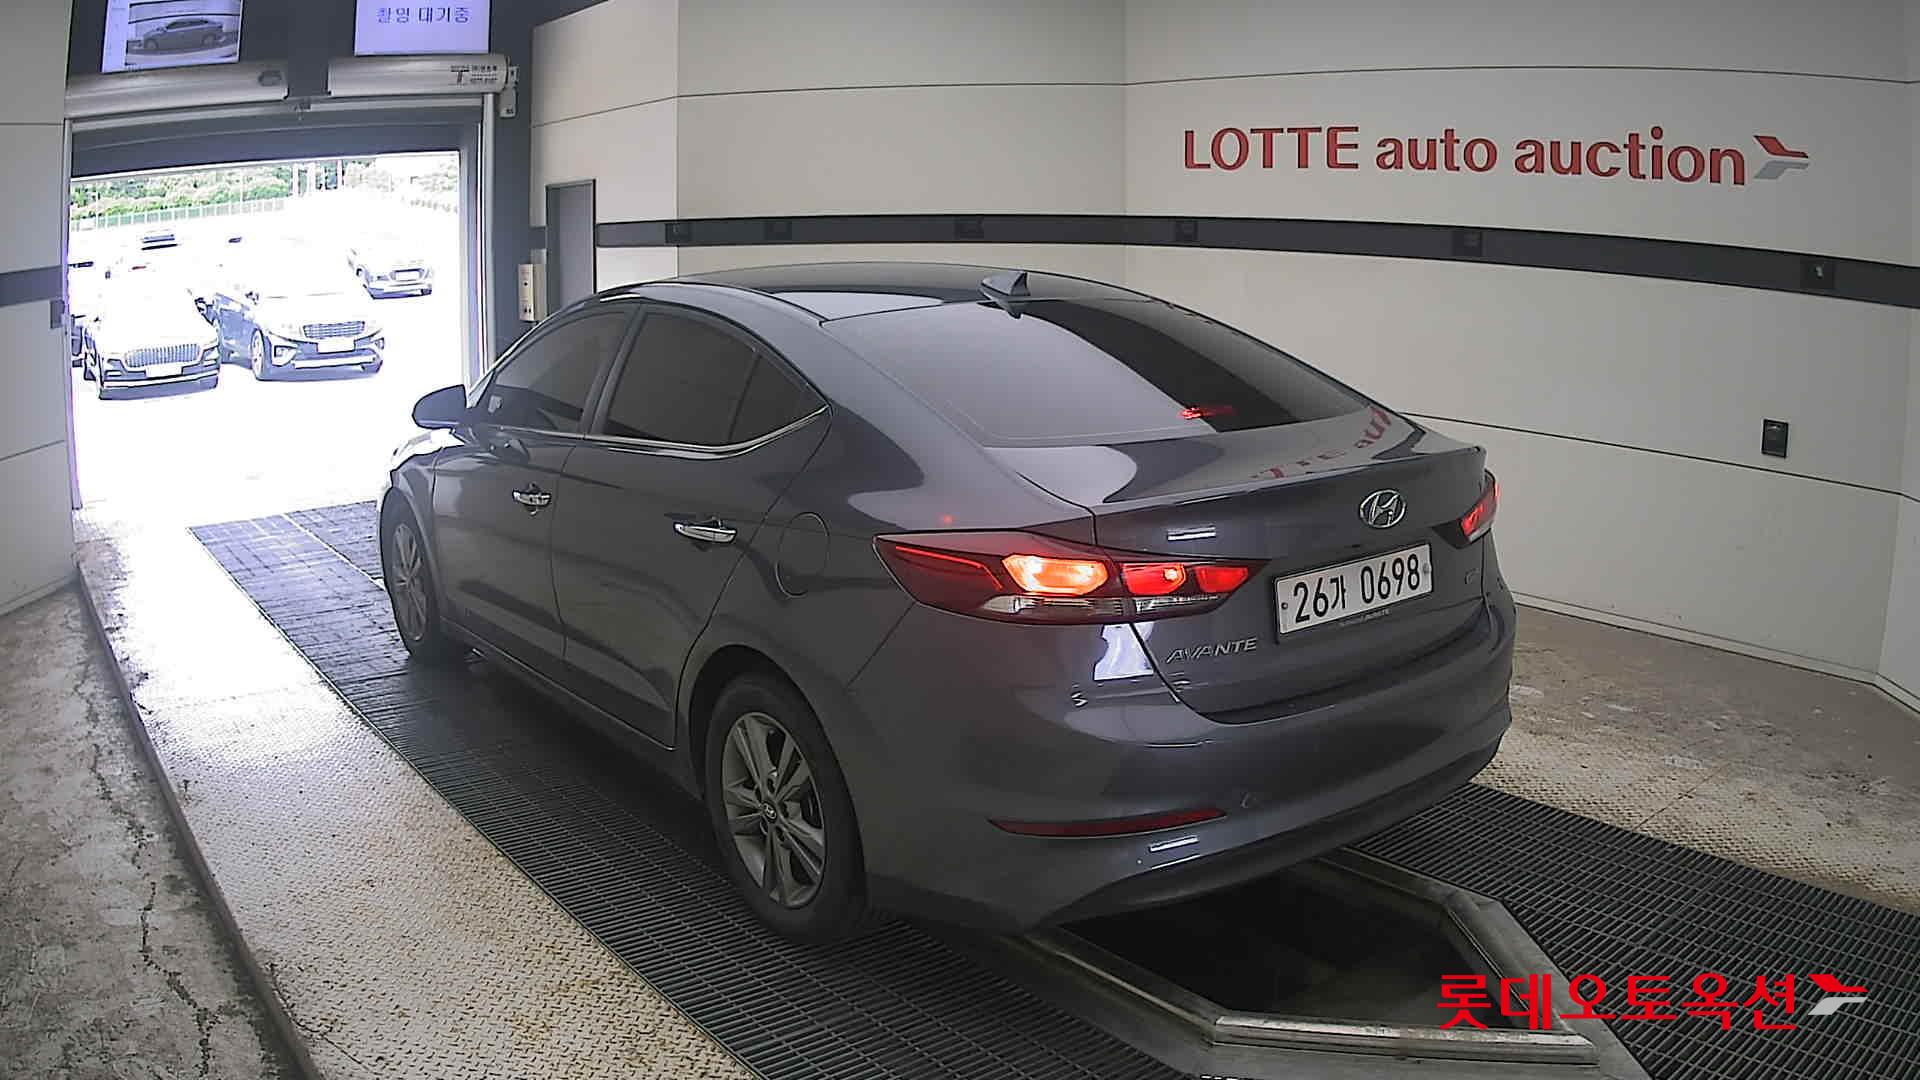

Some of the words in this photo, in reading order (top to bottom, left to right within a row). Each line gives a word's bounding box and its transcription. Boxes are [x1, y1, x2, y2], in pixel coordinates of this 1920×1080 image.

[418, 7, 469, 24] 대기중
[1184, 126, 1360, 171] LOTTE
[1376, 128, 1498, 172] auto
[1515, 126, 1746, 186] auction
[1293, 575, 1347, 623] 26가
[1360, 553, 1421, 604] 0698
[1166, 636, 1258, 664] AVANTE
